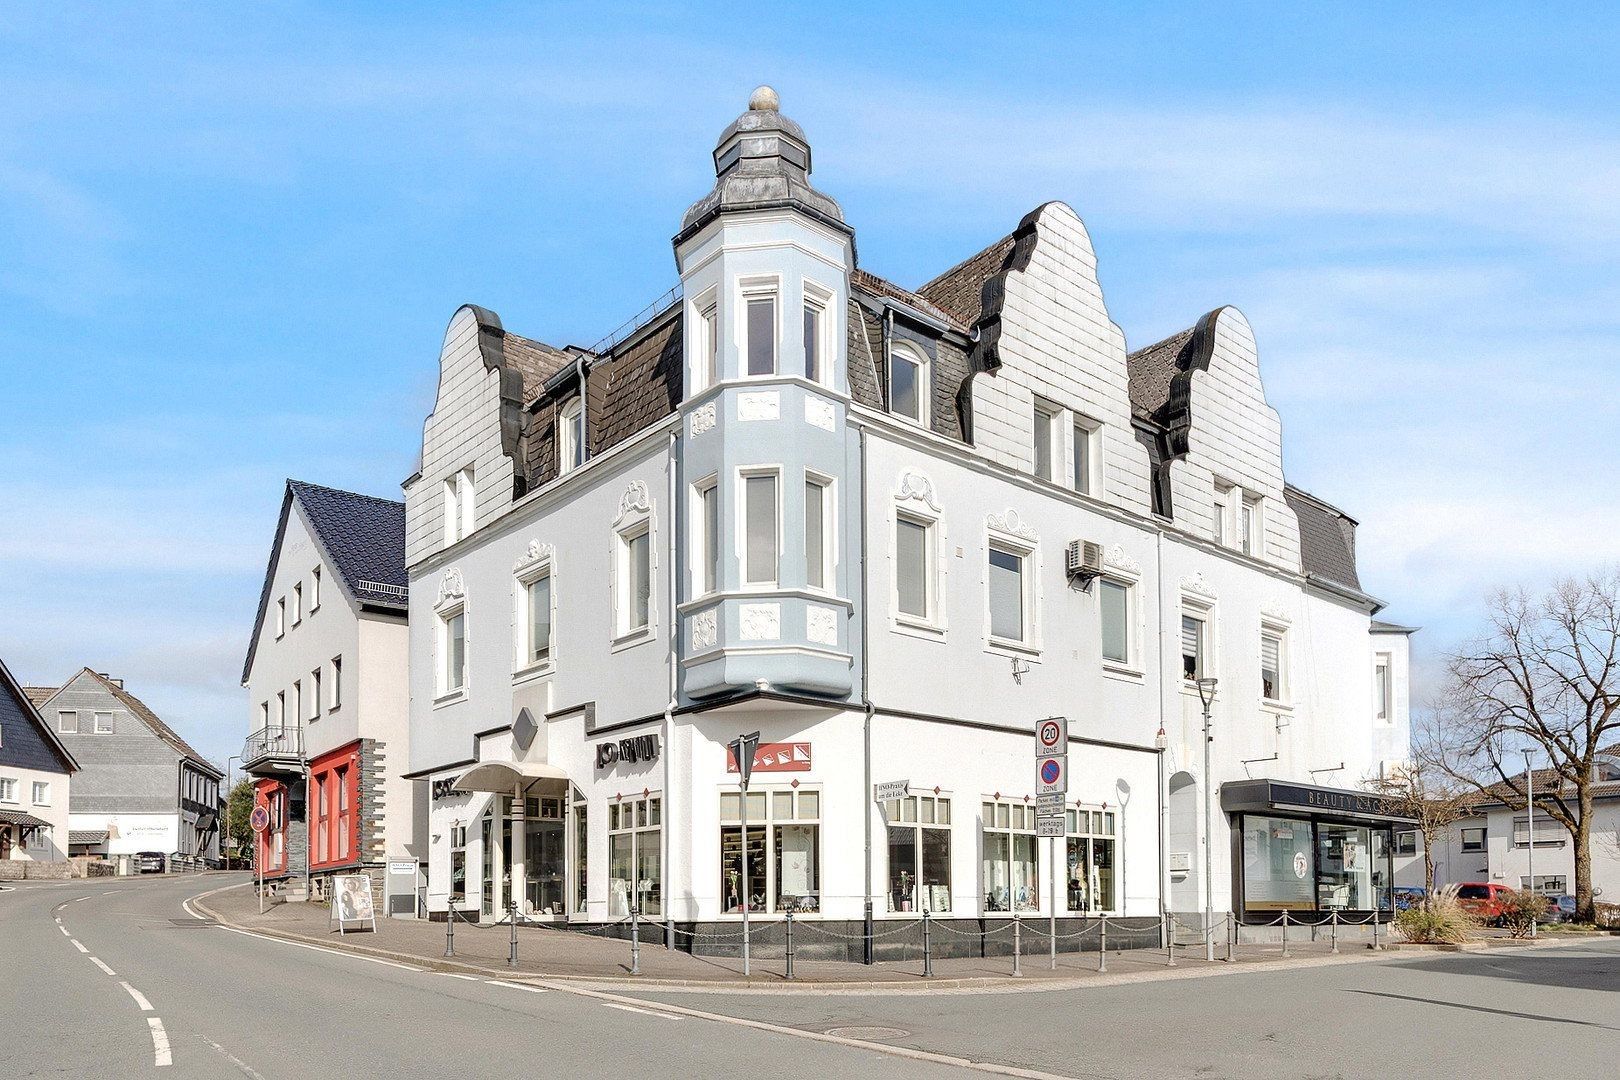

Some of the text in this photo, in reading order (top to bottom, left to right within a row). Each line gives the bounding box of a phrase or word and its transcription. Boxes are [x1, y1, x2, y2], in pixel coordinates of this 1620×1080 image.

[1045, 727, 1056, 740] 20
[1043, 746, 1058, 755] ZONE
[1043, 784, 1058, 793] ZONE
[1309, 792, 1352, 811] BEAUTY
